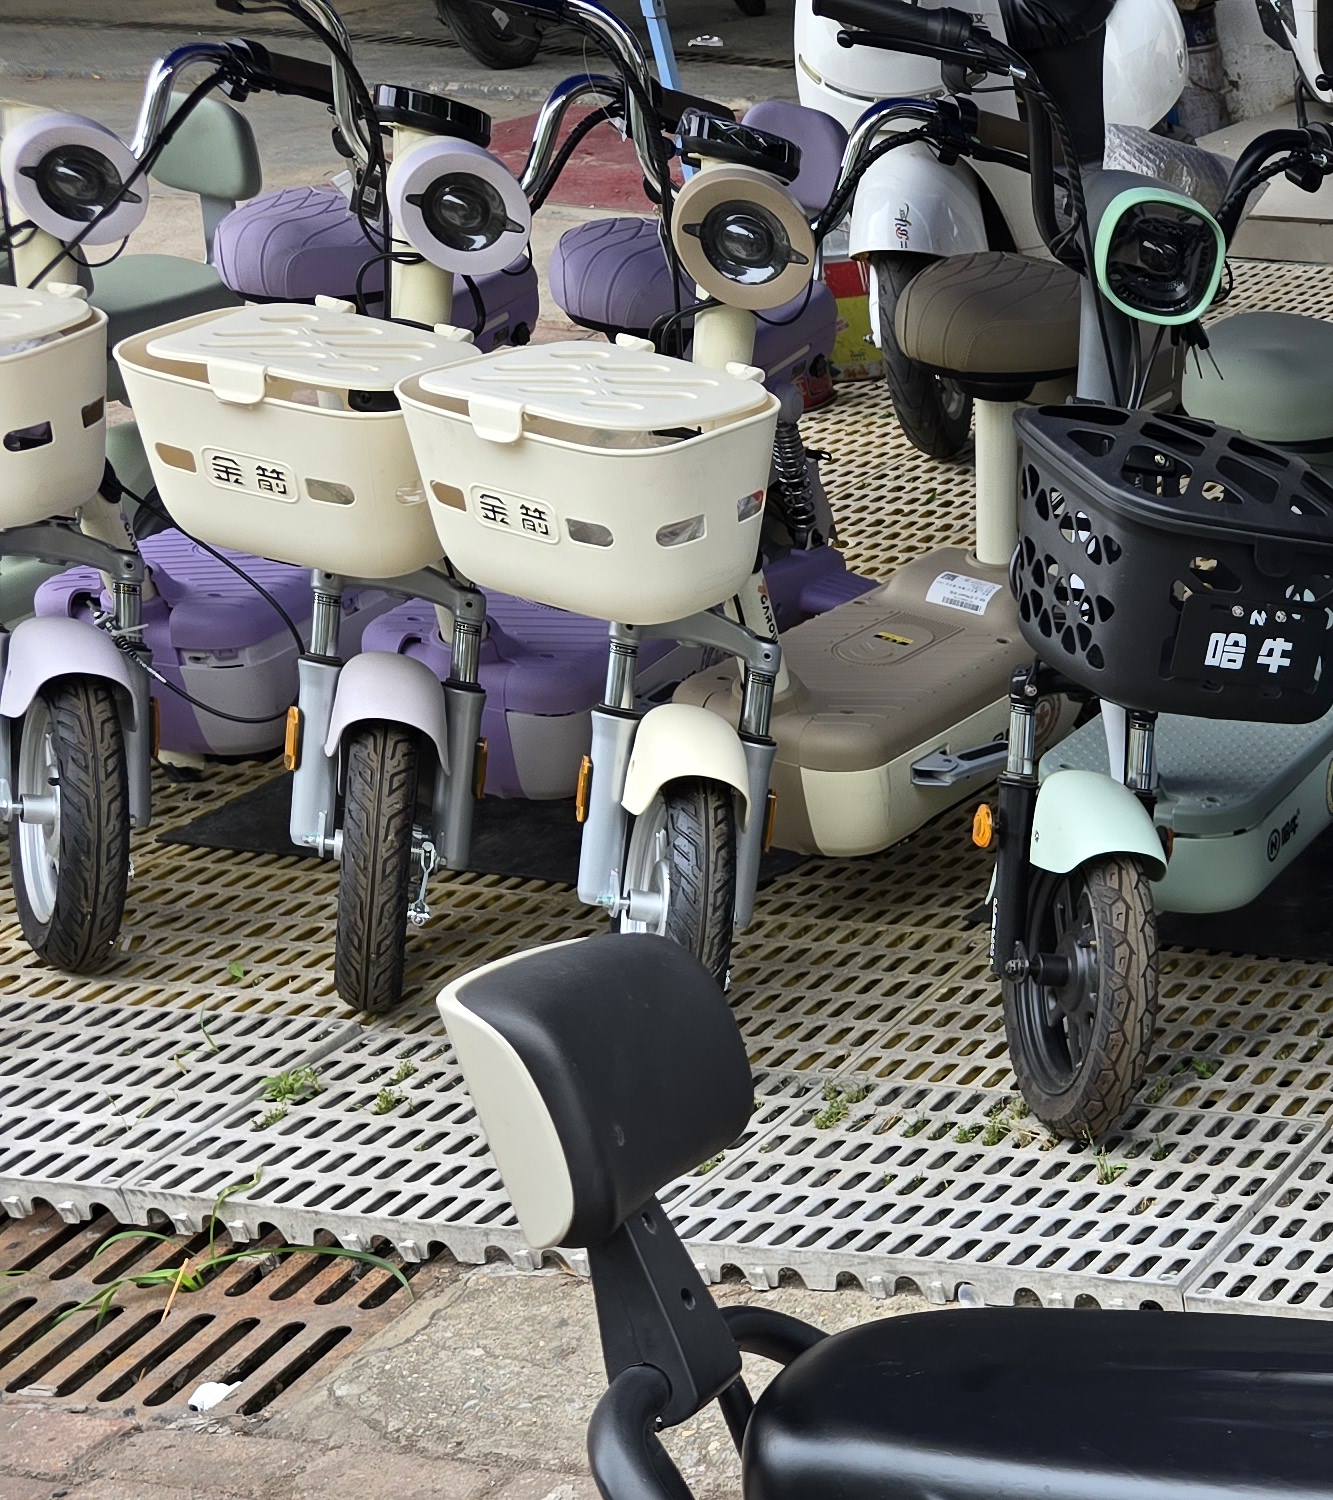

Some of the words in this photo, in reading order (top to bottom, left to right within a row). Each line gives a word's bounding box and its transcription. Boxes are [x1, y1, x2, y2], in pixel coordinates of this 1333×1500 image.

[211, 455, 288, 495] 金箭
[479, 493, 550, 536] 金箭
[1204, 632, 1294, 674] 哈牛
